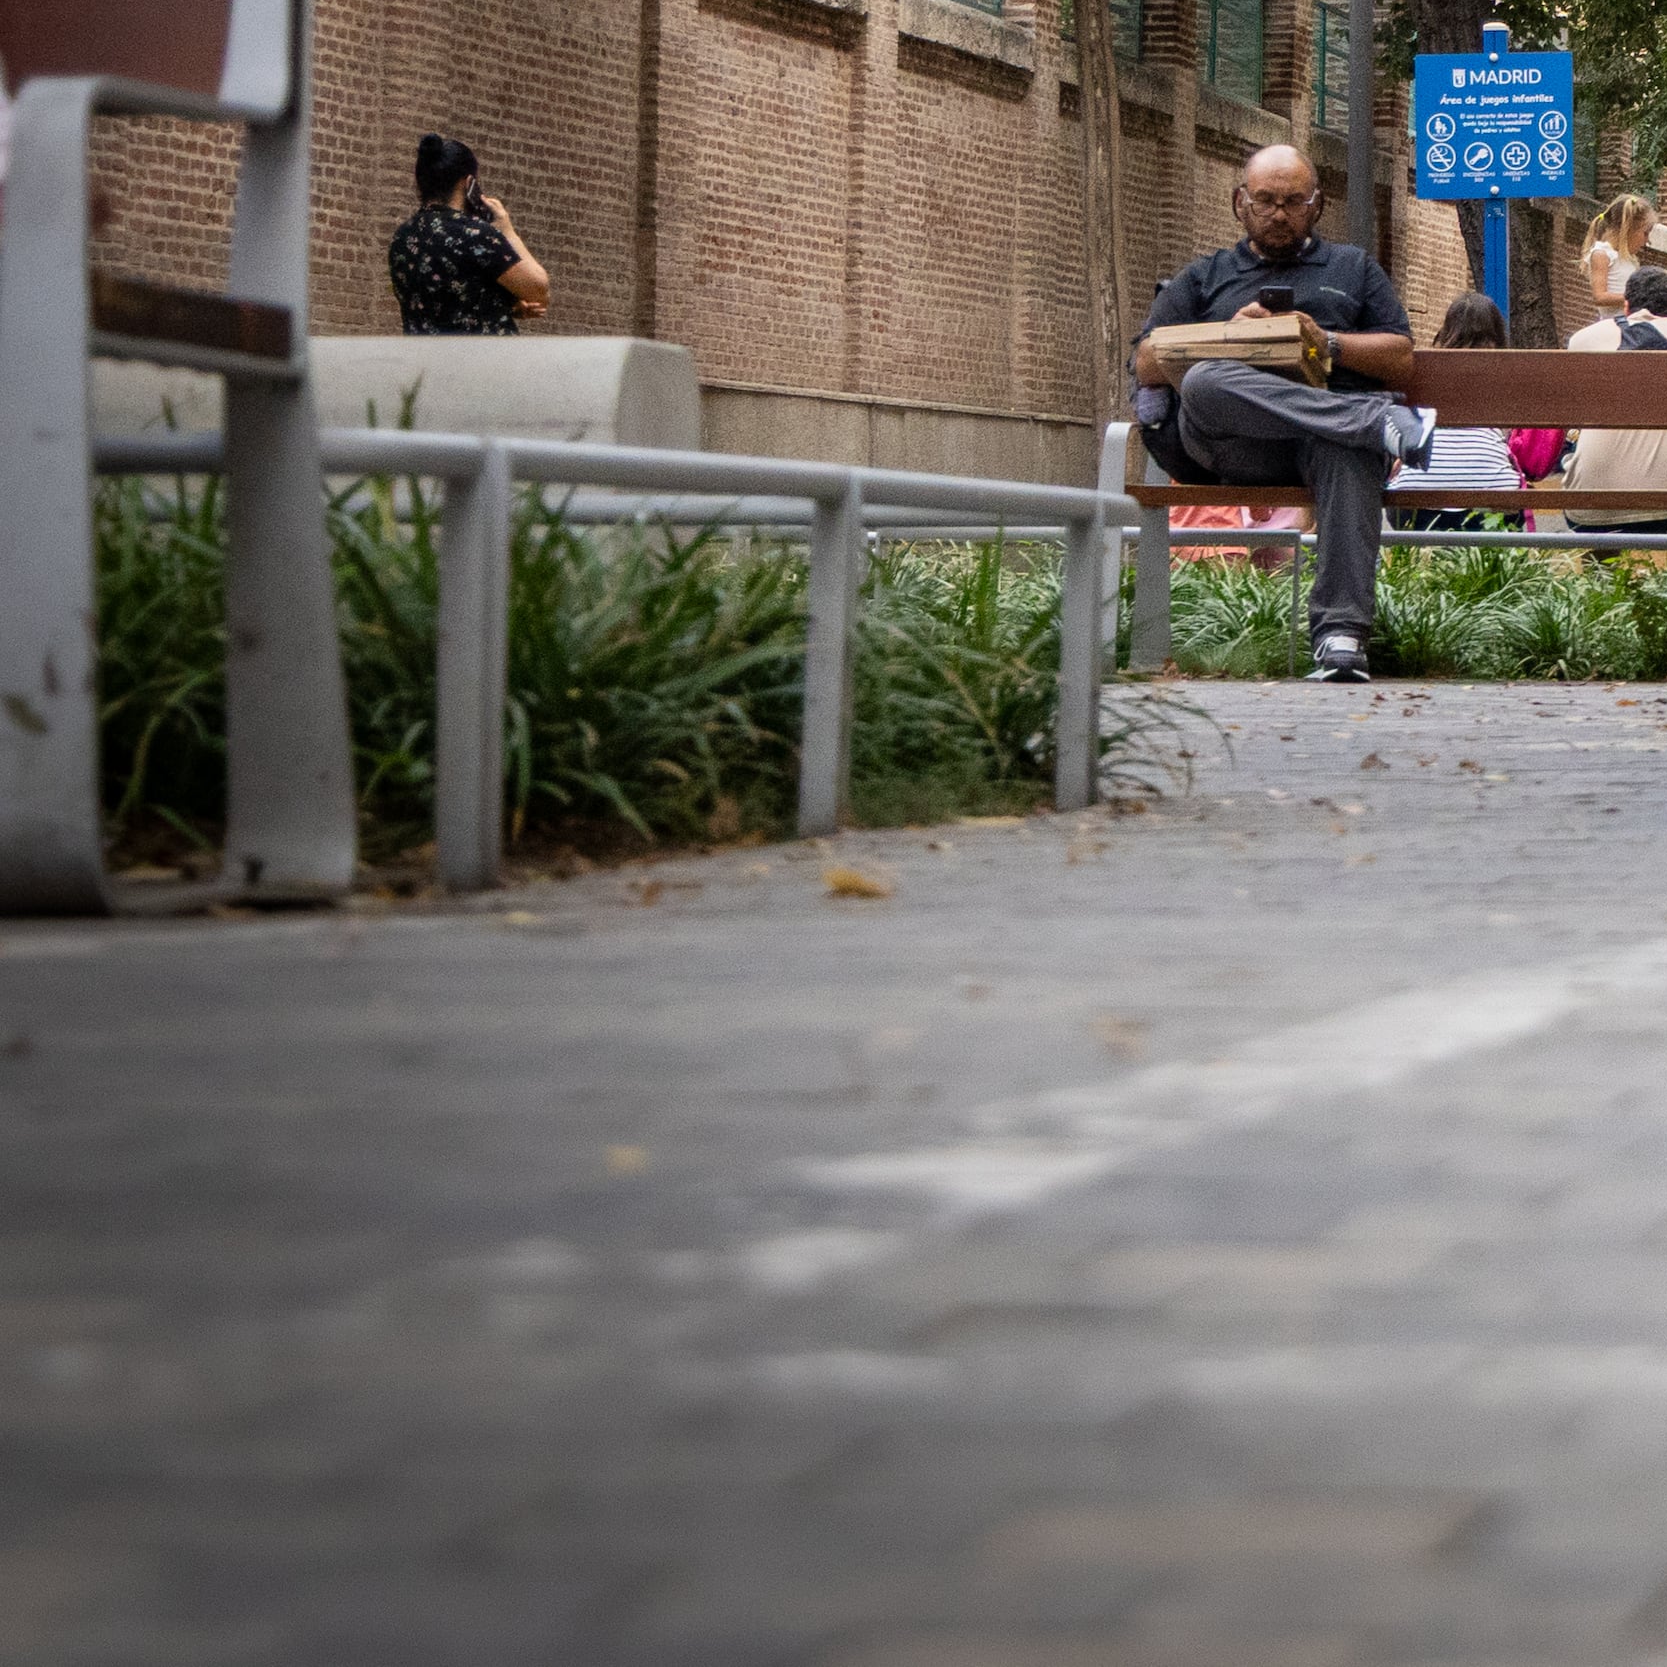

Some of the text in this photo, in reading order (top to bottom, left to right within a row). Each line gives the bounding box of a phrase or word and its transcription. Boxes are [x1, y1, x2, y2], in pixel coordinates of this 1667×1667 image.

[1470, 68, 1542, 85] MADRID
[1440, 94, 1554, 106] Área de juegos infantiles
